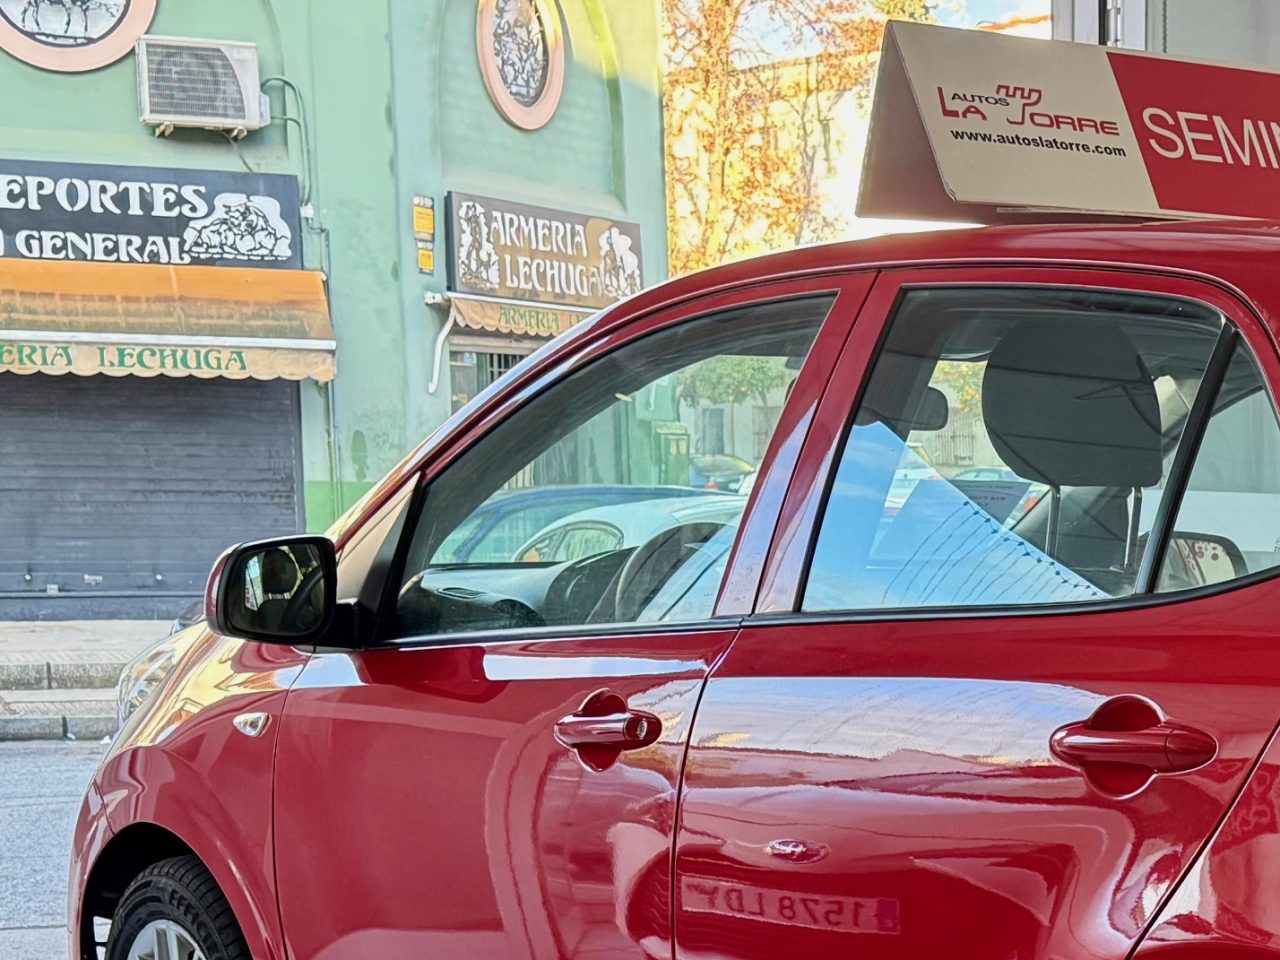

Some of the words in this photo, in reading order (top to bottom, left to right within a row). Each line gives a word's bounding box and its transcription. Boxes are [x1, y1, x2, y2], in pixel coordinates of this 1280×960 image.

[937, 86, 987, 121] LA
[951, 93, 1010, 107] AUTOS
[950, 129, 1127, 157] www.autoslatorre.com
[15, 229, 192, 264] GENERAL
[489, 210, 588, 257] ARMERIA
[504, 254, 601, 297] LECHUGA
[498, 306, 560, 331] ARMERIA
[98, 345, 247, 371] LECHUGA
